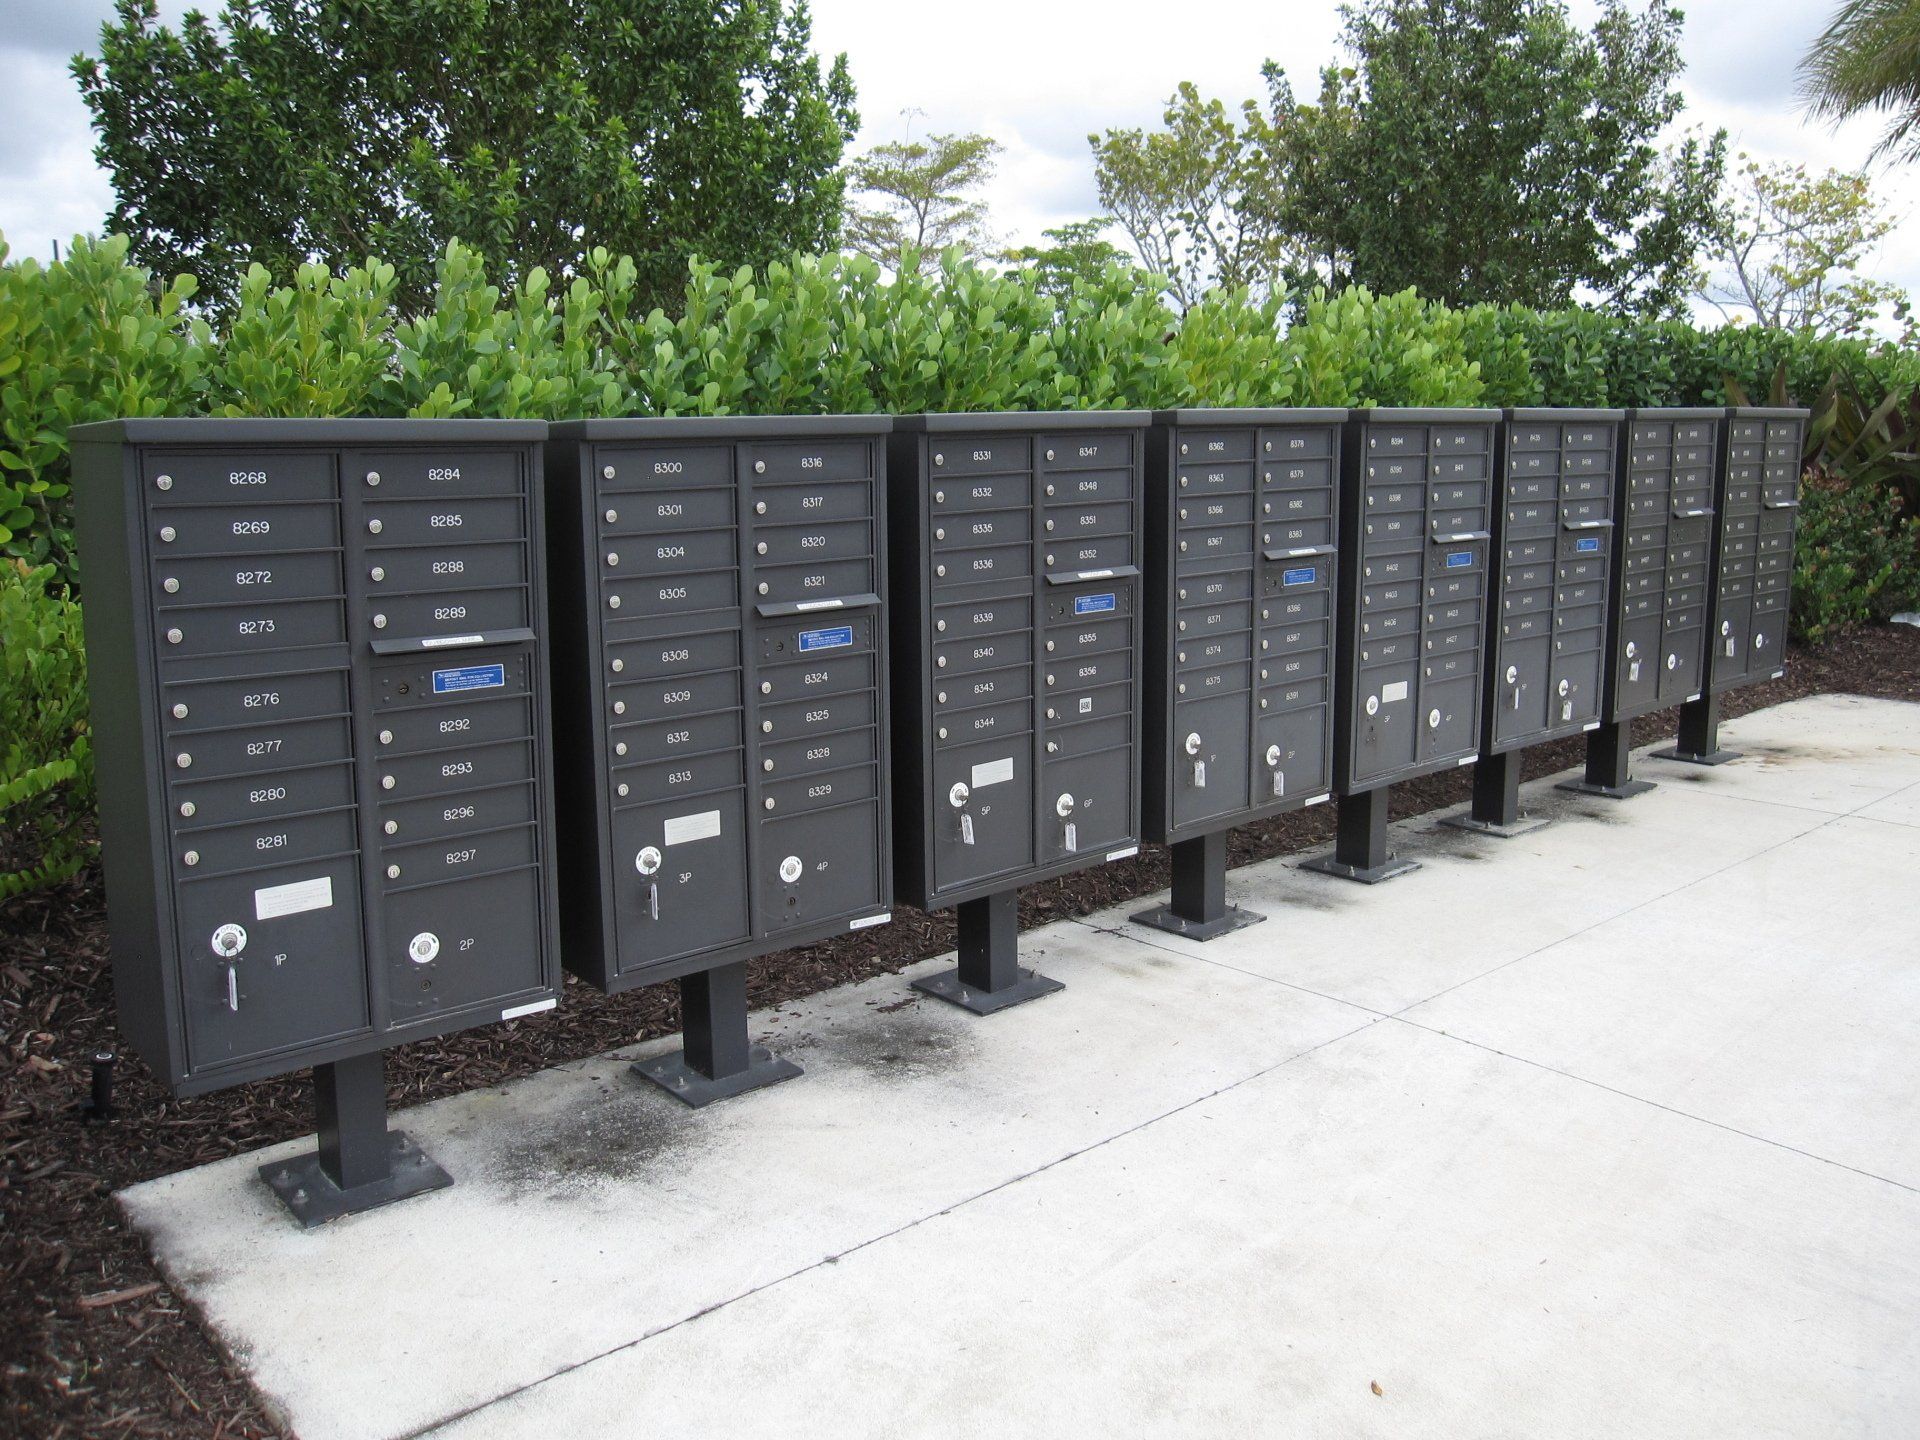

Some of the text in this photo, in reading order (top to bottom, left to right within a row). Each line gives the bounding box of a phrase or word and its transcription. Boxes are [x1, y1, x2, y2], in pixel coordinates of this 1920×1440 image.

[1208, 441, 1225, 451] 8362
[1289, 439, 1305, 449] 8378
[973, 450, 992, 461] 8331
[1078, 446, 1098, 457] 8347
[654, 461, 683, 474] 8300
[801, 457, 823, 469] 8316
[229, 471, 267, 485] 8268
[428, 468, 461, 481] 8284
[1208, 473, 1225, 483] 8363
[1289, 469, 1304, 479] 8379
[1078, 481, 1098, 491] 8348
[972, 487, 993, 498] 8332
[802, 496, 824, 508] 8317
[1288, 499, 1303, 509] 8382
[657, 504, 682, 517] 8301
[1207, 505, 1224, 515] 8366
[430, 514, 463, 528] 8285
[1079, 515, 1097, 526] 8351
[232, 520, 270, 535] 8269
[972, 523, 993, 534] 8335
[1288, 529, 1303, 539] 8383
[801, 535, 826, 548] 8320
[1207, 536, 1223, 547] 8367
[657, 546, 685, 559] 8304
[1079, 549, 1097, 560] 8352
[432, 560, 465, 574] 8288
[973, 558, 994, 570] 8336
[236, 570, 273, 585] 8272
[804, 575, 826, 587] 8321
[659, 587, 687, 600] 8305
[1206, 583, 1223, 594] 8370
[434, 606, 467, 620] 8289
[1286, 603, 1302, 613] 8386
[973, 612, 994, 624] 8339
[1207, 614, 1221, 625] 8371
[239, 619, 276, 635] 8273
[1078, 632, 1097, 644] 8355
[1286, 632, 1301, 643] 8387
[661, 649, 689, 663] 8308
[973, 646, 995, 659] 8340
[1205, 644, 1221, 656] 8374
[1078, 665, 1097, 677] 8356
[1285, 661, 1301, 672] 8390
[804, 671, 829, 685] 8324
[1205, 675, 1221, 686] 8375
[973, 682, 995, 694] 8343
[243, 692, 280, 708] 8276
[663, 690, 691, 704] 8309
[1285, 690, 1299, 701] 8391
[805, 709, 830, 723] 8325
[439, 718, 471, 733] 8292
[974, 716, 995, 730] 8344
[666, 730, 690, 744] 8312
[247, 739, 282, 756] 8277
[806, 747, 831, 760] 8328
[441, 761, 473, 777] 8293
[668, 770, 692, 784] 8313
[249, 787, 286, 803] 8280
[808, 784, 832, 798] 8329
[1083, 798, 1093, 809] 6P
[443, 805, 475, 821] 8296
[980, 805, 991, 816] 5P
[256, 834, 287, 850] 8281
[446, 848, 477, 865] 8297
[816, 861, 829, 872] 4P
[678, 871, 692, 884] 3P
[220, 925, 239, 935] OPEN
[459, 937, 475, 951] 2P
[274, 953, 287, 966] 1P
